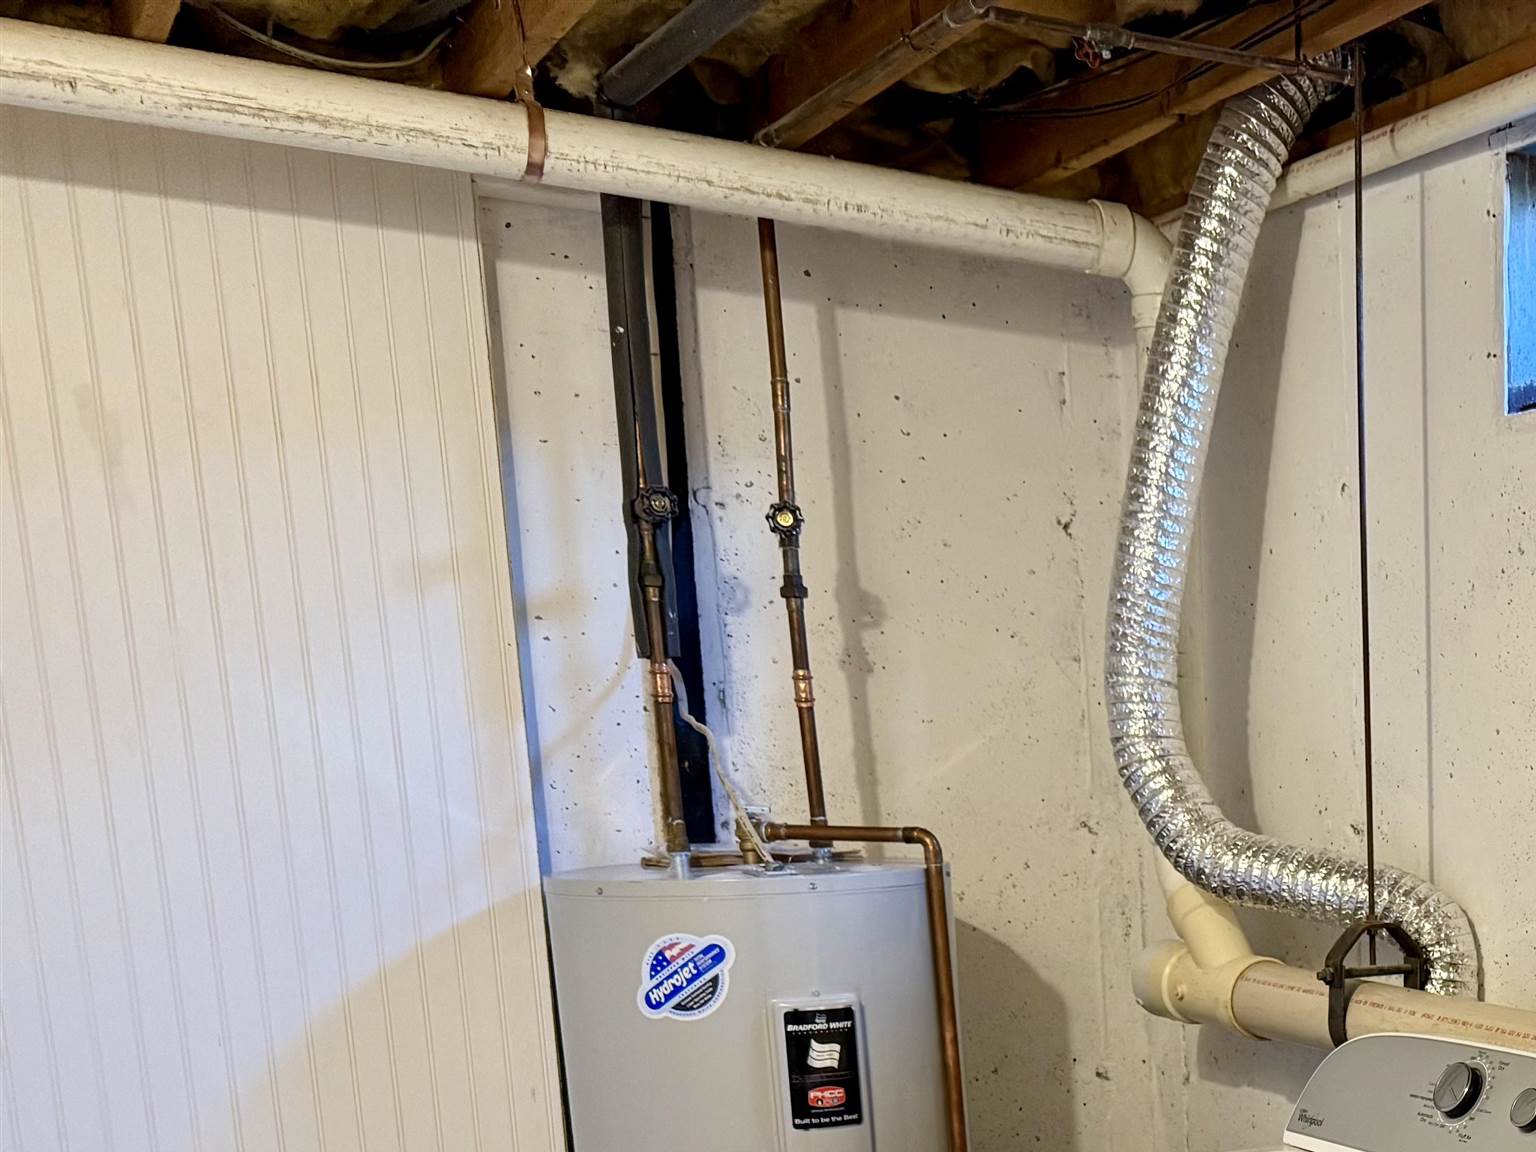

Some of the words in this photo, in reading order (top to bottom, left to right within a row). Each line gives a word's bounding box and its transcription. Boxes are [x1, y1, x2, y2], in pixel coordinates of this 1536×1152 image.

[649, 961, 698, 1005] Hydrojet
[787, 1023, 828, 1032] BRADFORD
[829, 1021, 853, 1029] WHITE
